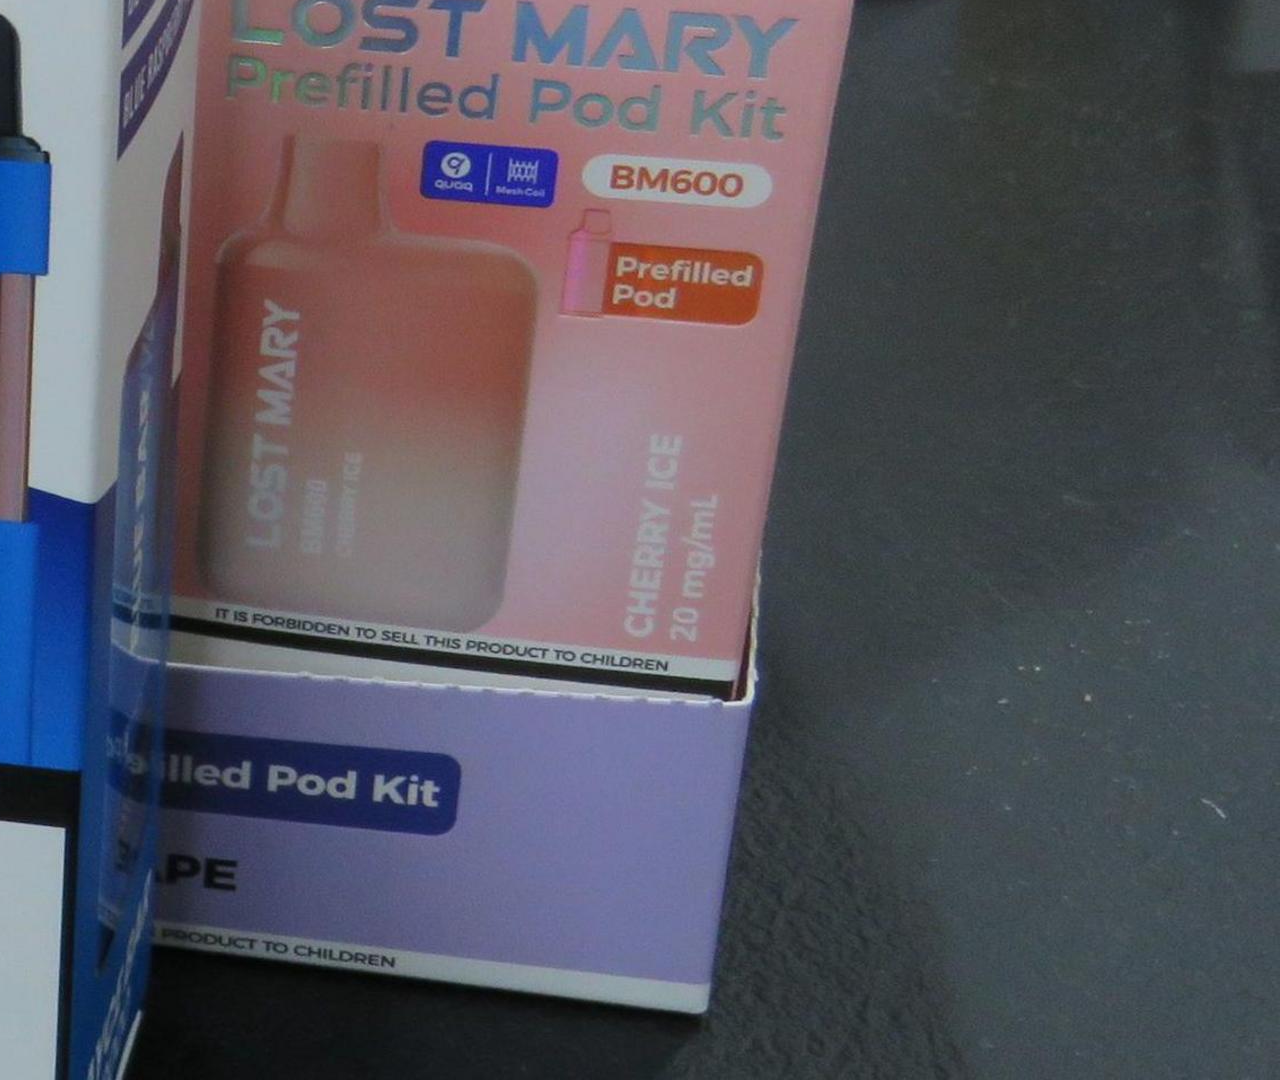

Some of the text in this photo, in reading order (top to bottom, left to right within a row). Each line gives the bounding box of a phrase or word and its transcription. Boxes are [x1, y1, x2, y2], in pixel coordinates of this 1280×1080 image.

[511, 0, 800, 80] MARY
[226, 52, 788, 142] Prefilled Pod Kit
[609, 164, 744, 198] BM600
[611, 282, 678, 311] Pod
[615, 255, 755, 289] Prefilled
[245, 298, 300, 549] LOST MARY
[624, 433, 684, 639] CHERRY ICE
[669, 493, 722, 642] 20 mg/mL
[214, 606, 670, 673] IT IS FORBIDDEN TO SELL THIS PRODUCT TO CHILDREN
[266, 763, 357, 800] Pod
[372, 773, 441, 808] Kit
[160, 928, 397, 970] PRODUCT TO CHILDREN
